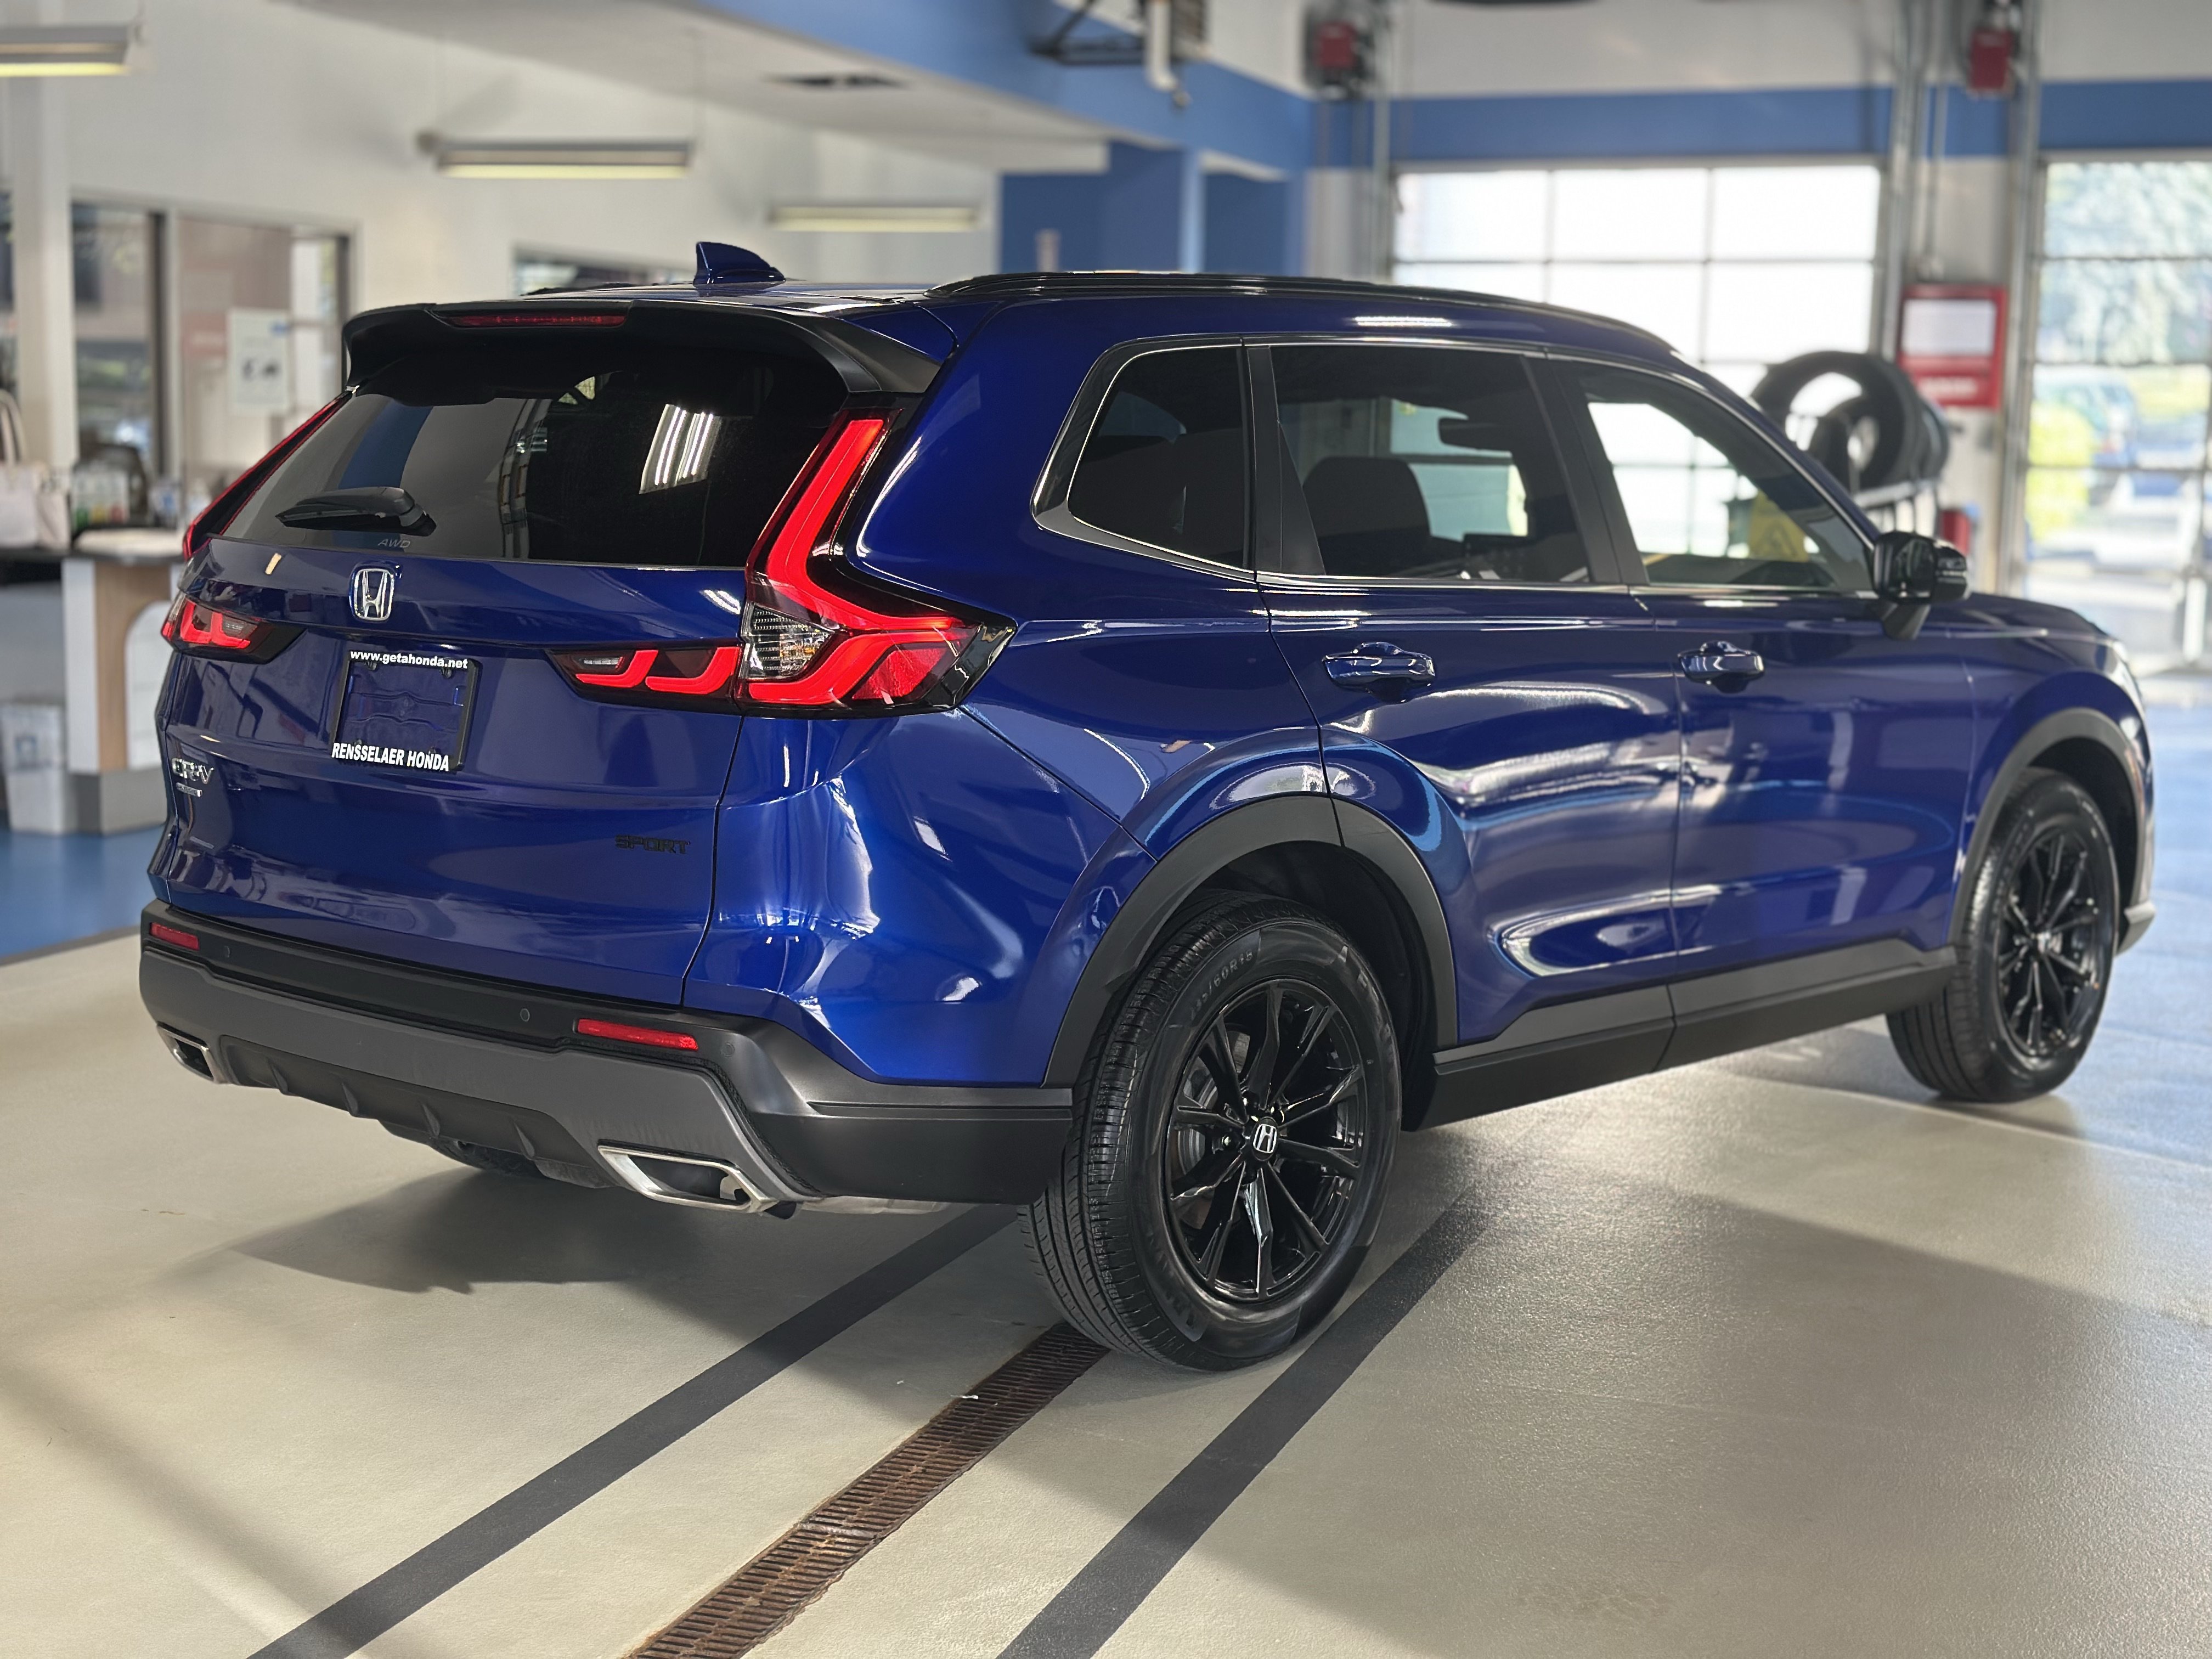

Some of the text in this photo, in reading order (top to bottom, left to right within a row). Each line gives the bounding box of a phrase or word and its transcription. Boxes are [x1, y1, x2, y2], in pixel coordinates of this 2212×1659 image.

[377, 538, 410, 548] AWD
[350, 651, 468, 669] www.getahonda.net
[331, 742, 449, 771] RENSSELAER HONDA
[614, 834, 690, 854] SPORT
